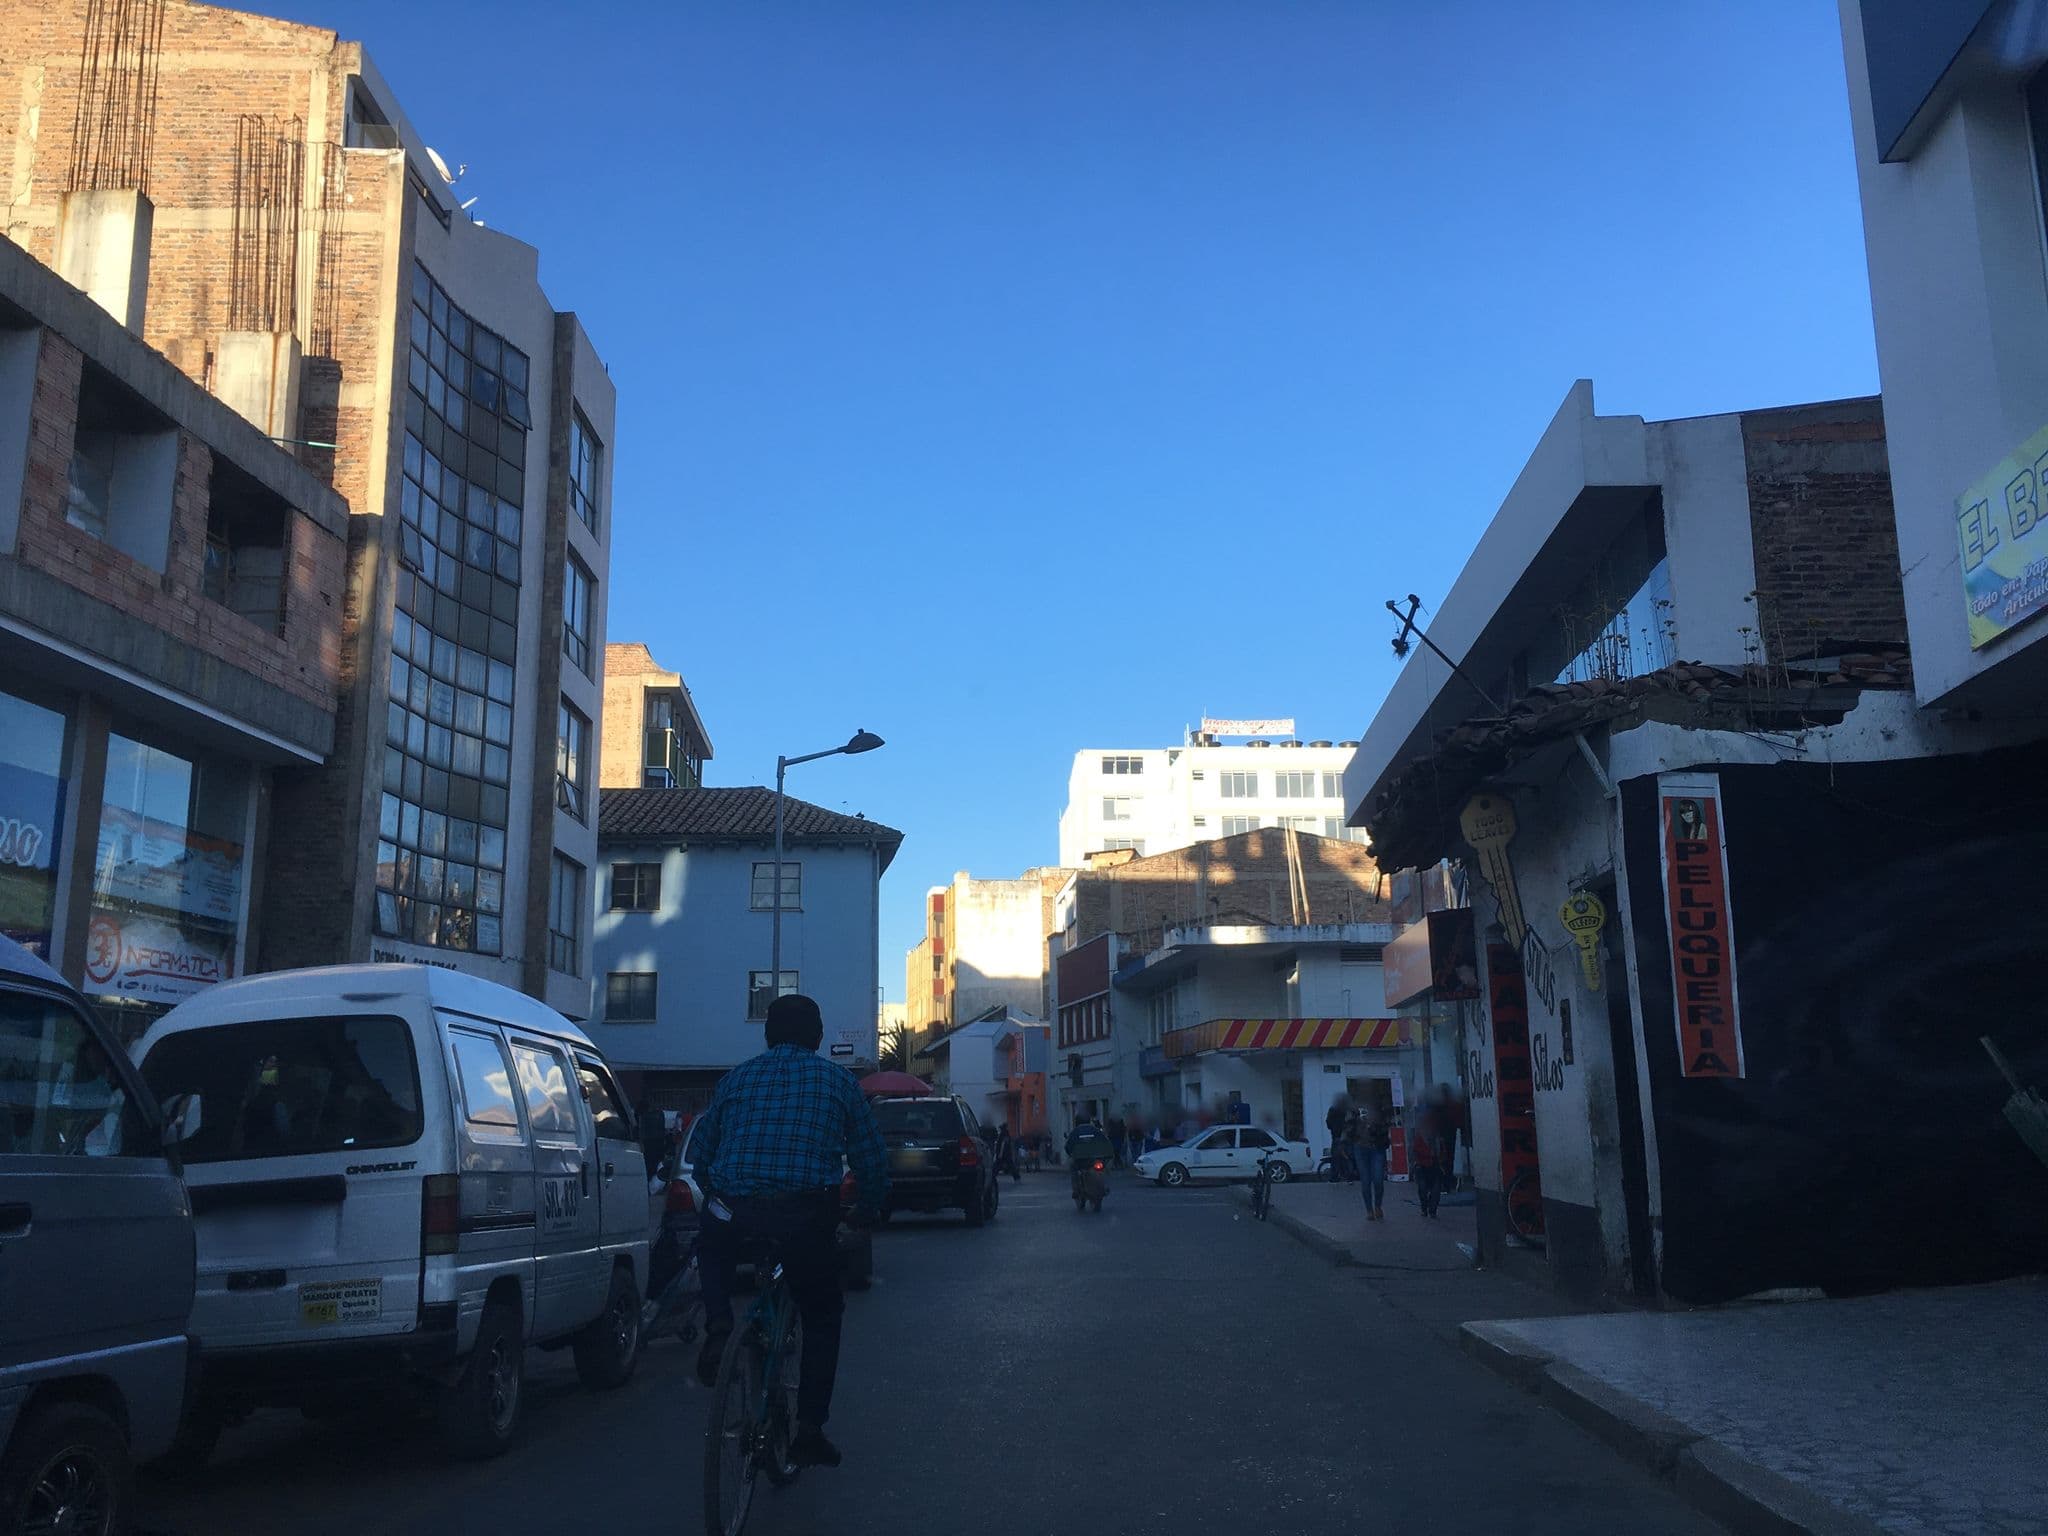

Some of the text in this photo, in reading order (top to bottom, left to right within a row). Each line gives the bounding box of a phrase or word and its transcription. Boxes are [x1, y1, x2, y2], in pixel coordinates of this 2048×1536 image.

[1959, 498, 1999, 573] EL
[1675, 841, 1730, 1073] PELUQUERIA
[346, 1160, 417, 1175] CHEVROLET
[344, 1289, 378, 1298] GRATIS
